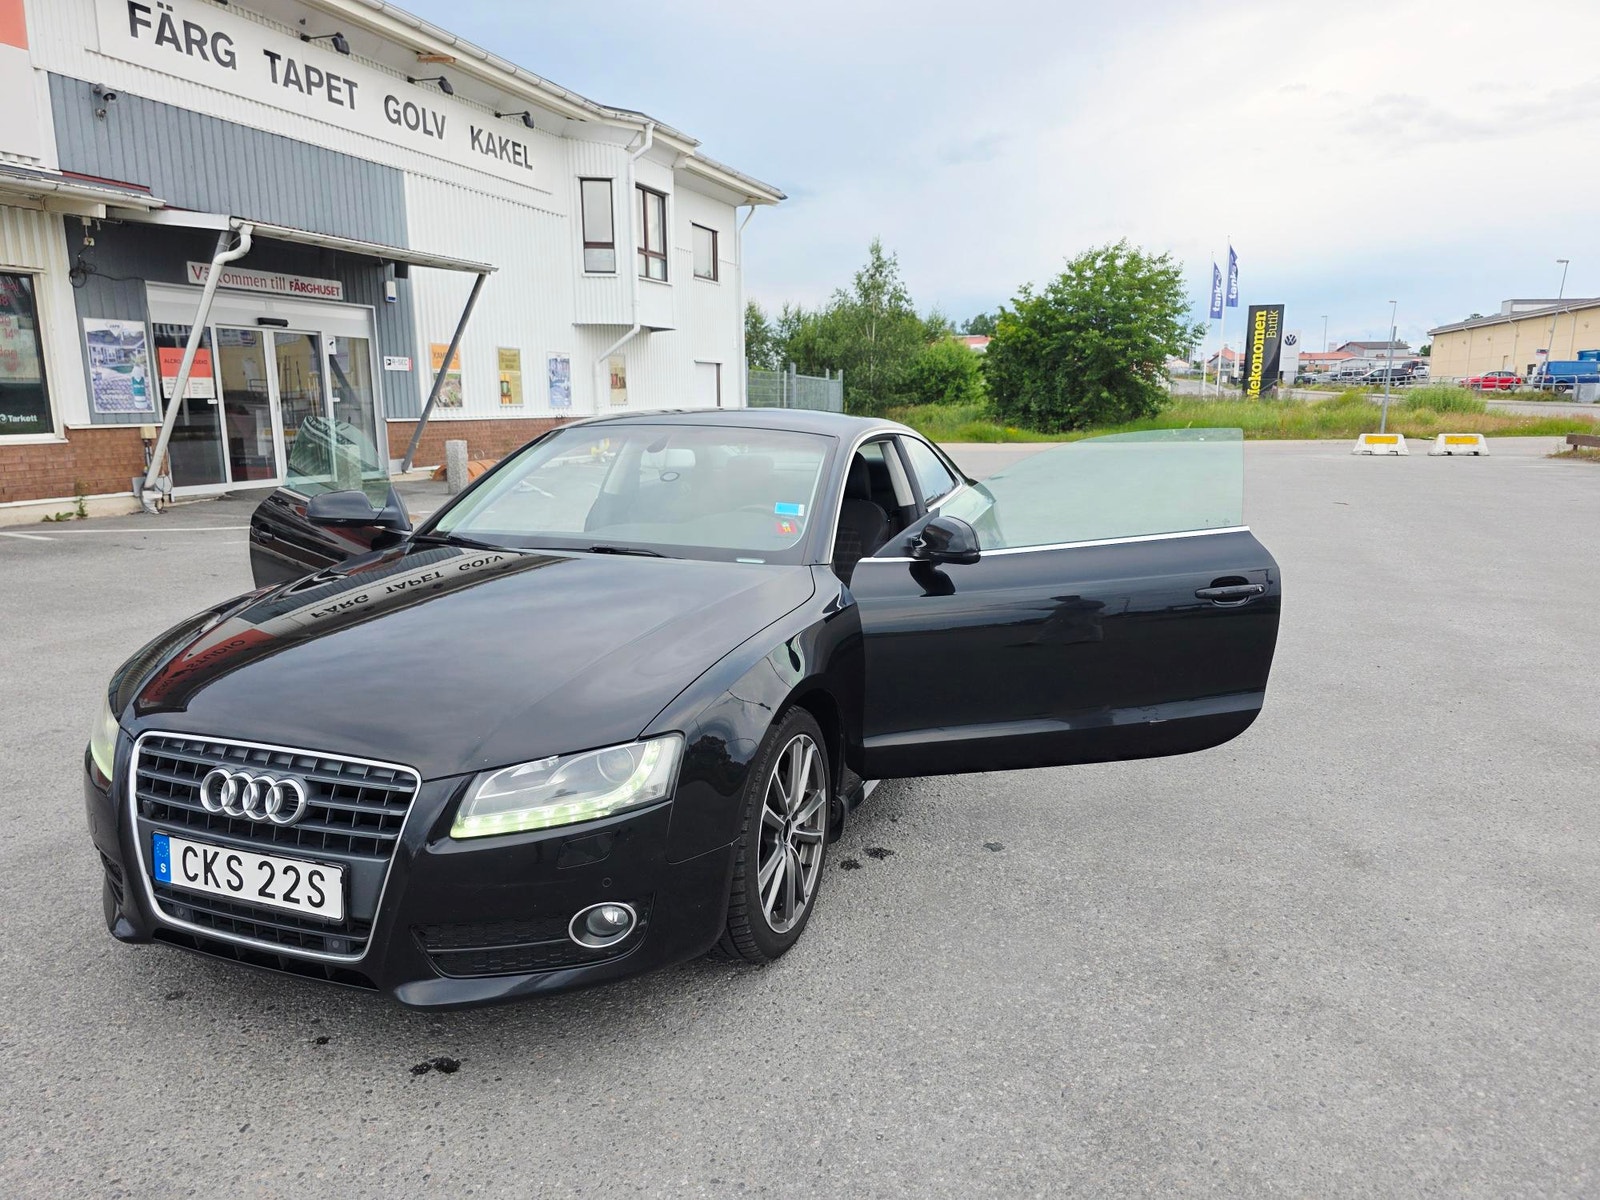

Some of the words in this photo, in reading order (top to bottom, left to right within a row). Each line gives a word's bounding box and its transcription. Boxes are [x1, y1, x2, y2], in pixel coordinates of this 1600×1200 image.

[127, 1, 237, 71] FÄRG
[263, 49, 359, 110] TAPET
[384, 94, 446, 141] GOLV
[470, 125, 534, 171] KAKEL
[191, 265, 268, 289] Väommen
[271, 277, 286, 291] till
[289, 278, 341, 297] FÄRGHUSET
[1266, 310, 1279, 338] Butik
[7, 414, 38, 423] Tarkett
[160, 863, 167, 874] S
[181, 845, 244, 892] CKS
[258, 860, 326, 908] 22S
